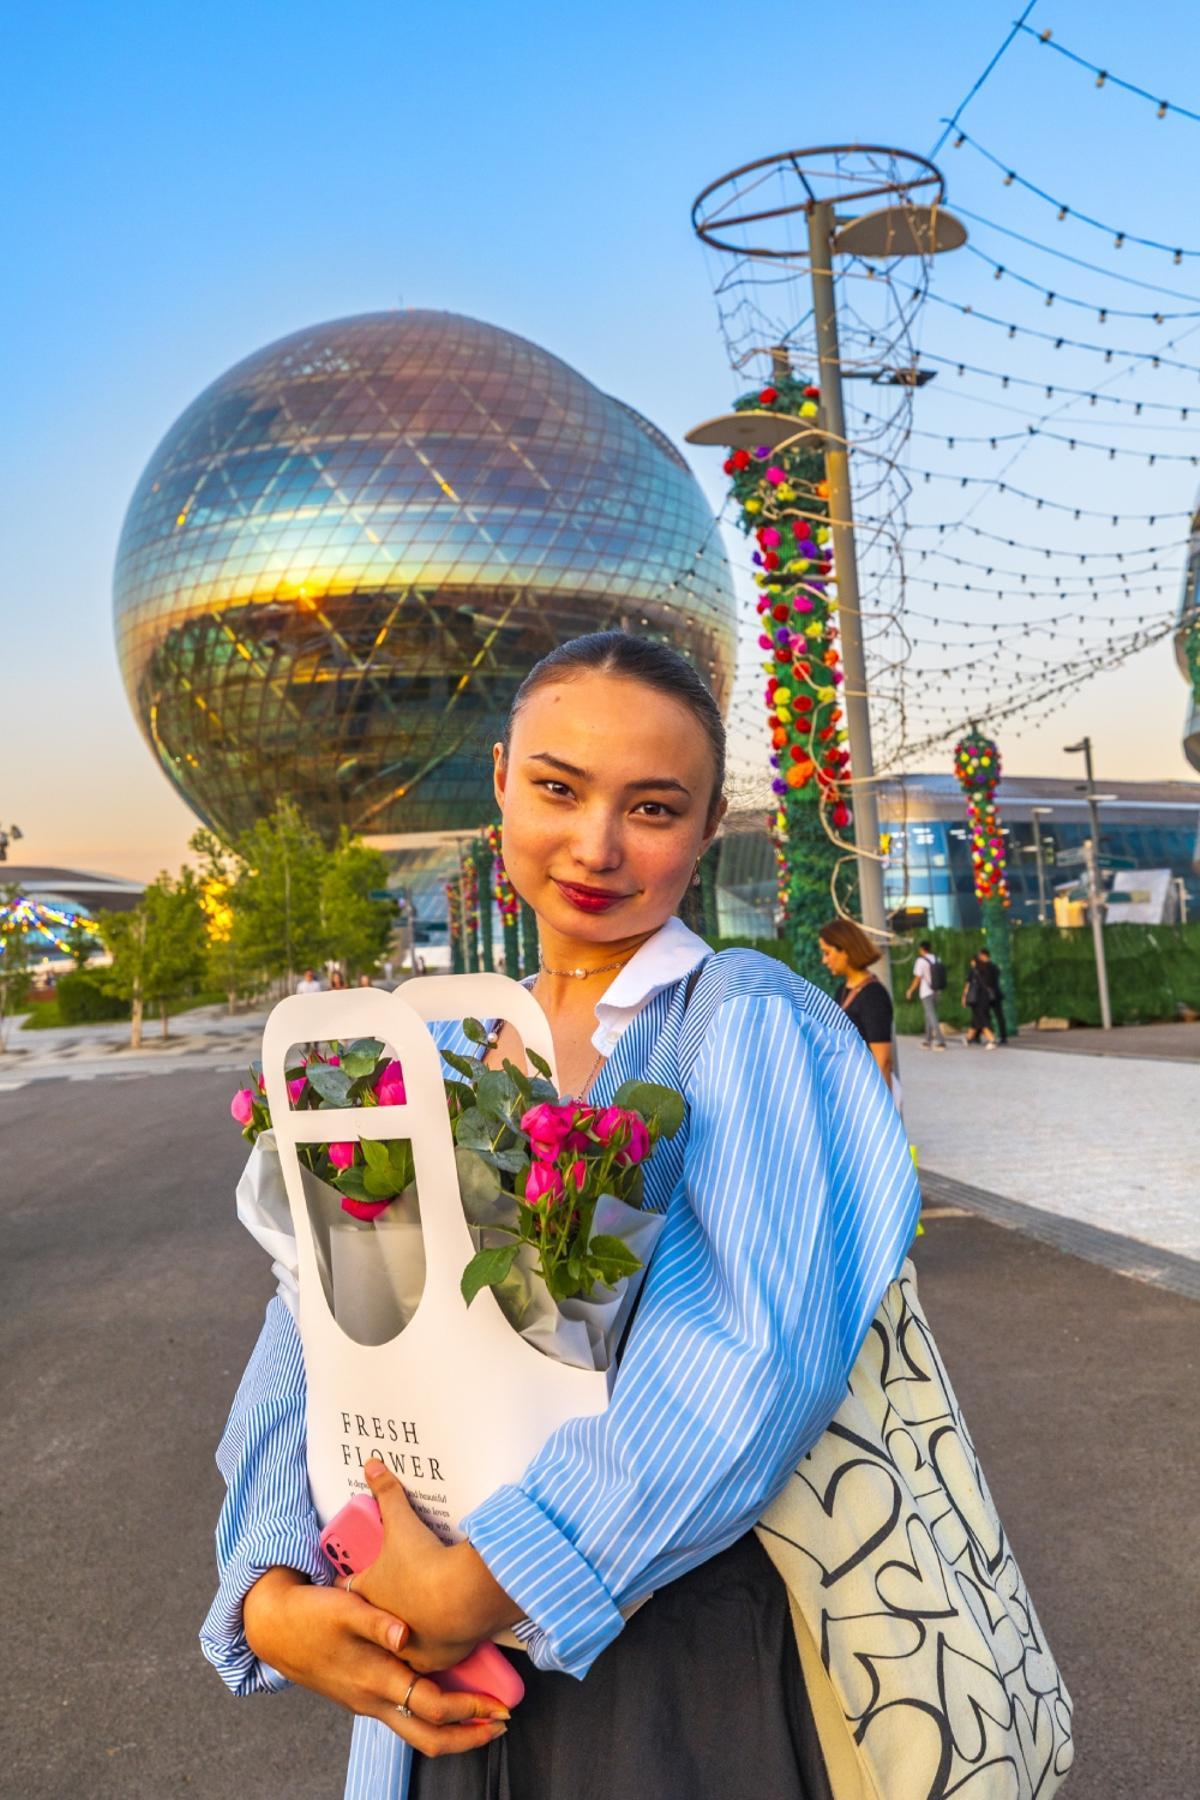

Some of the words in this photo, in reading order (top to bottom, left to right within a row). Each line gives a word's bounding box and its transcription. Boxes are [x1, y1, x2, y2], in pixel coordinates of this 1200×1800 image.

[341, 1412, 420, 1445] FRESH
[419, 1490, 447, 1504] beautiful
[432, 1506, 450, 1518] loves
